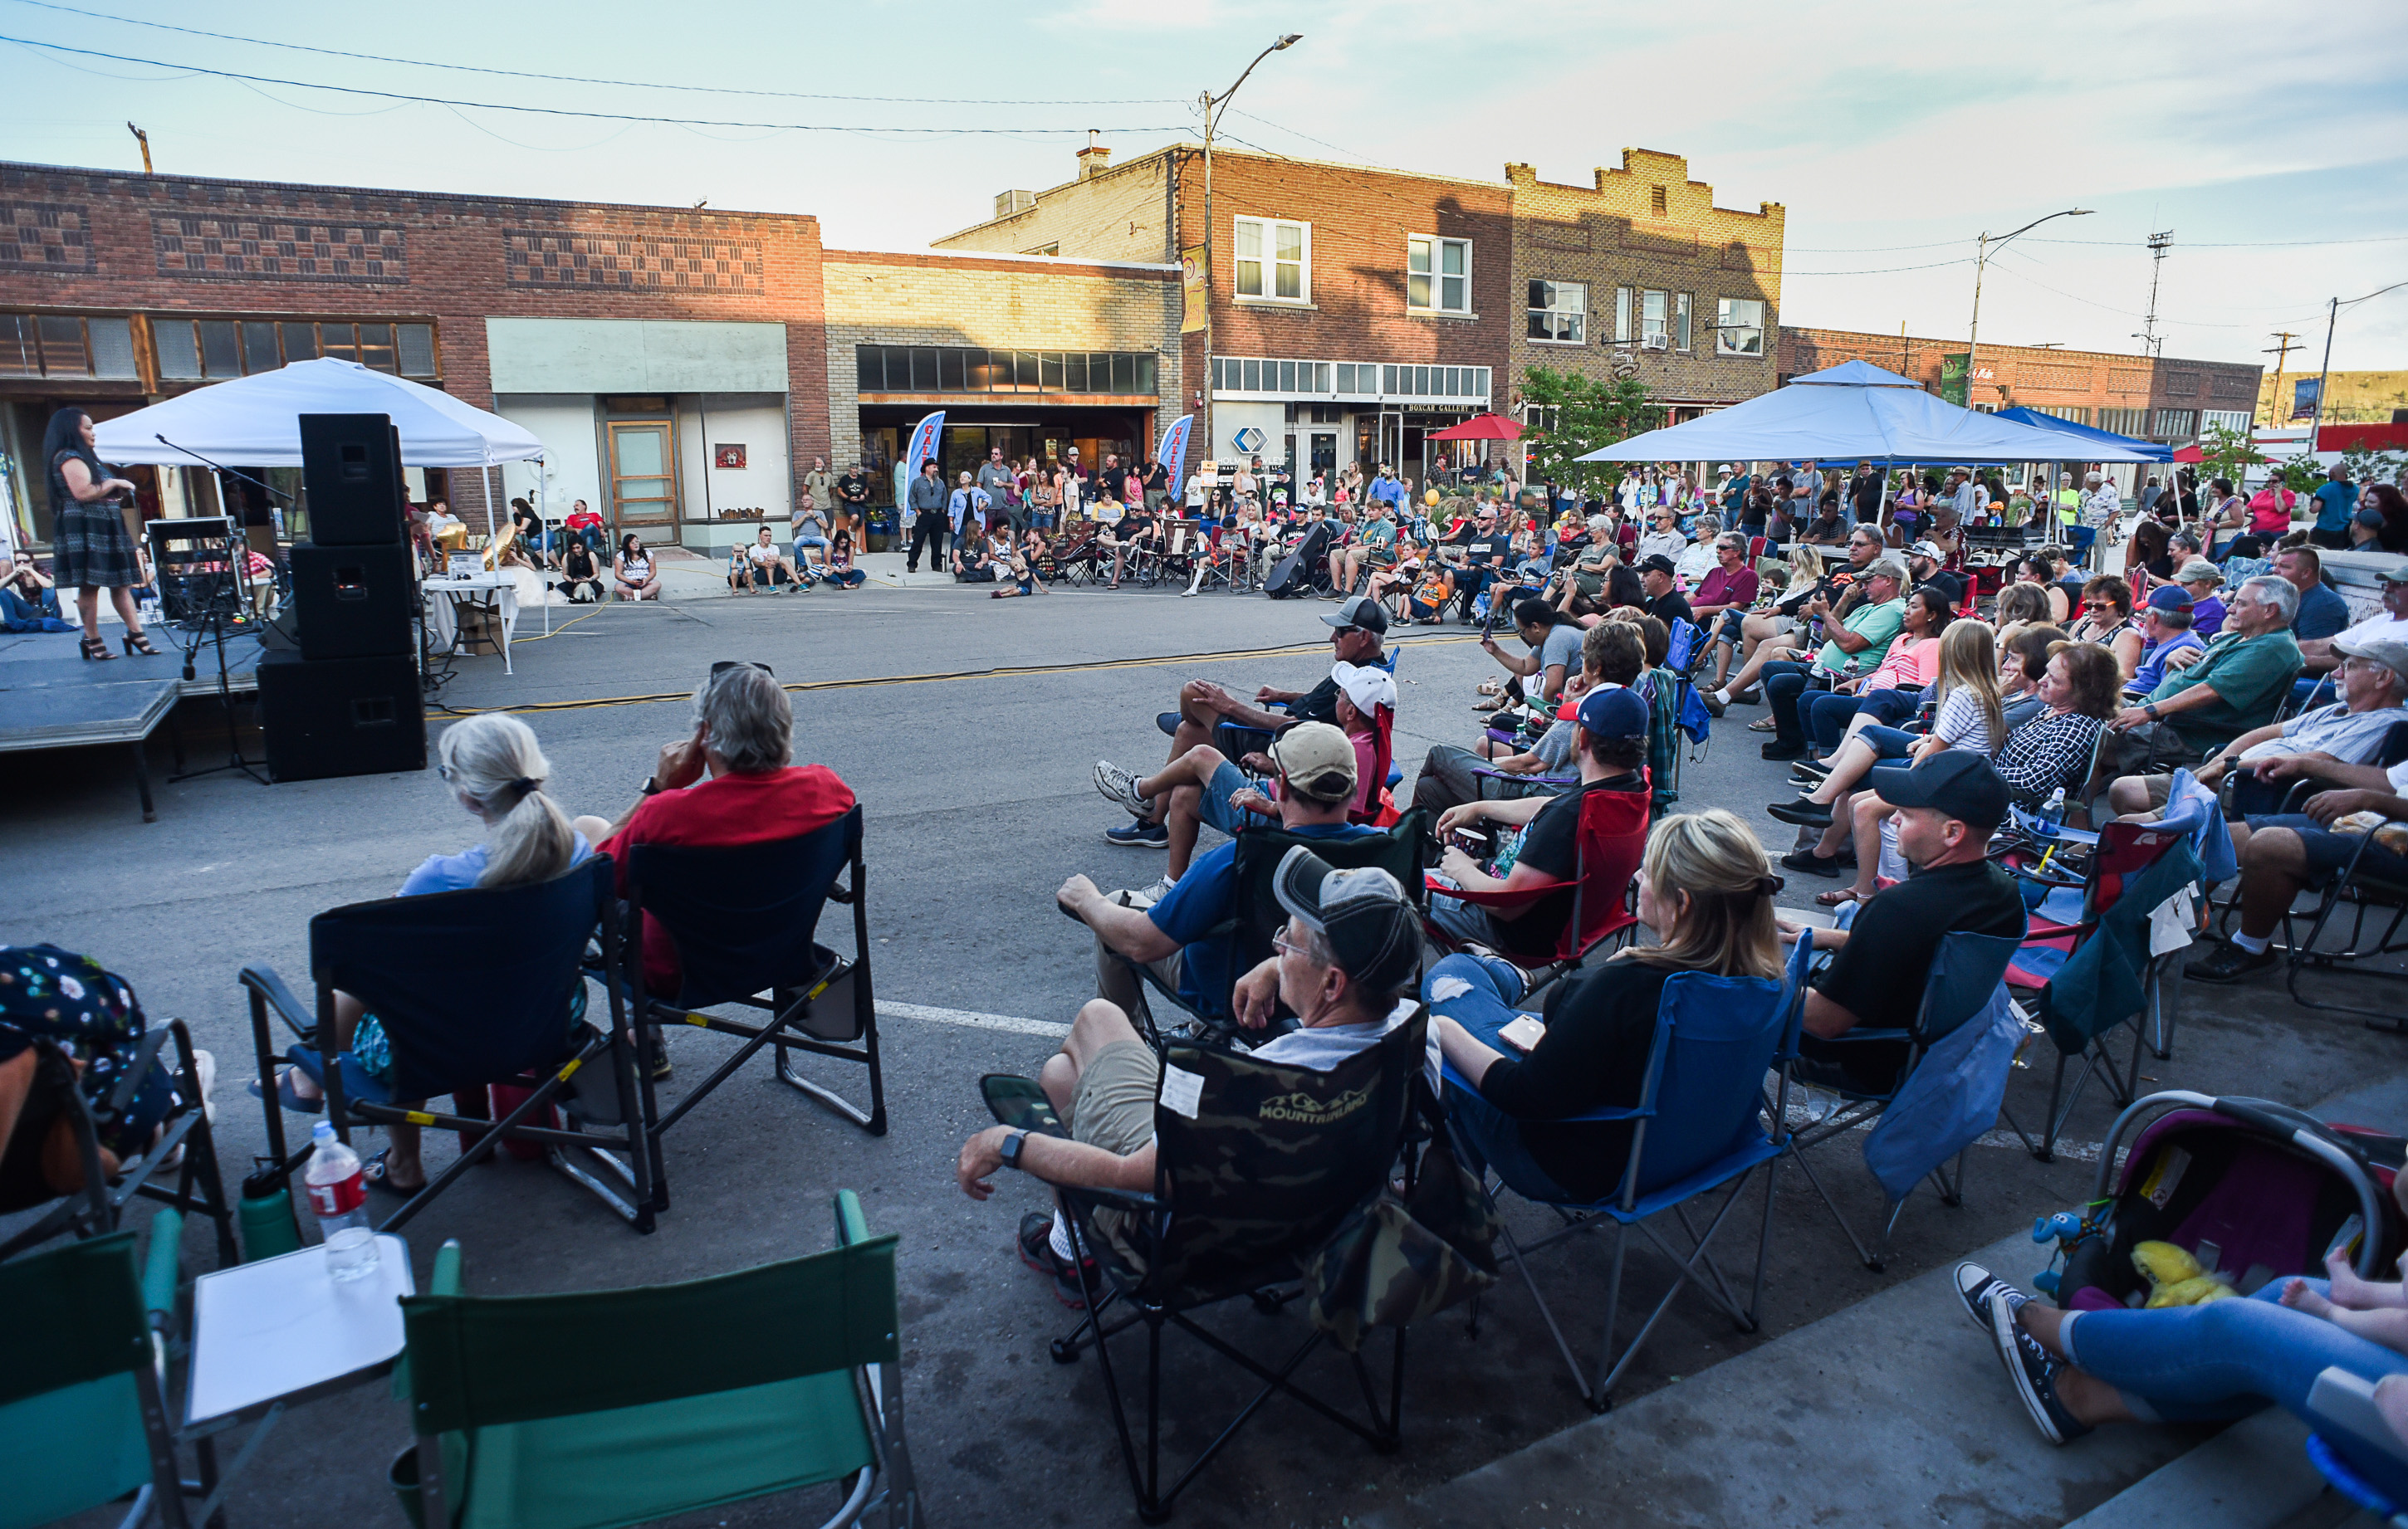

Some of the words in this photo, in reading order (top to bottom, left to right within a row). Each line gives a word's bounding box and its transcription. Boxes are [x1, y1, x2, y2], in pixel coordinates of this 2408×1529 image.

[1408, 403, 1436, 412] BOXCAR
[1439, 404, 1469, 413] GALLERY
[1168, 427, 1182, 493] GALLERY
[1259, 1093, 1368, 1124] MOUNTAINLAND
